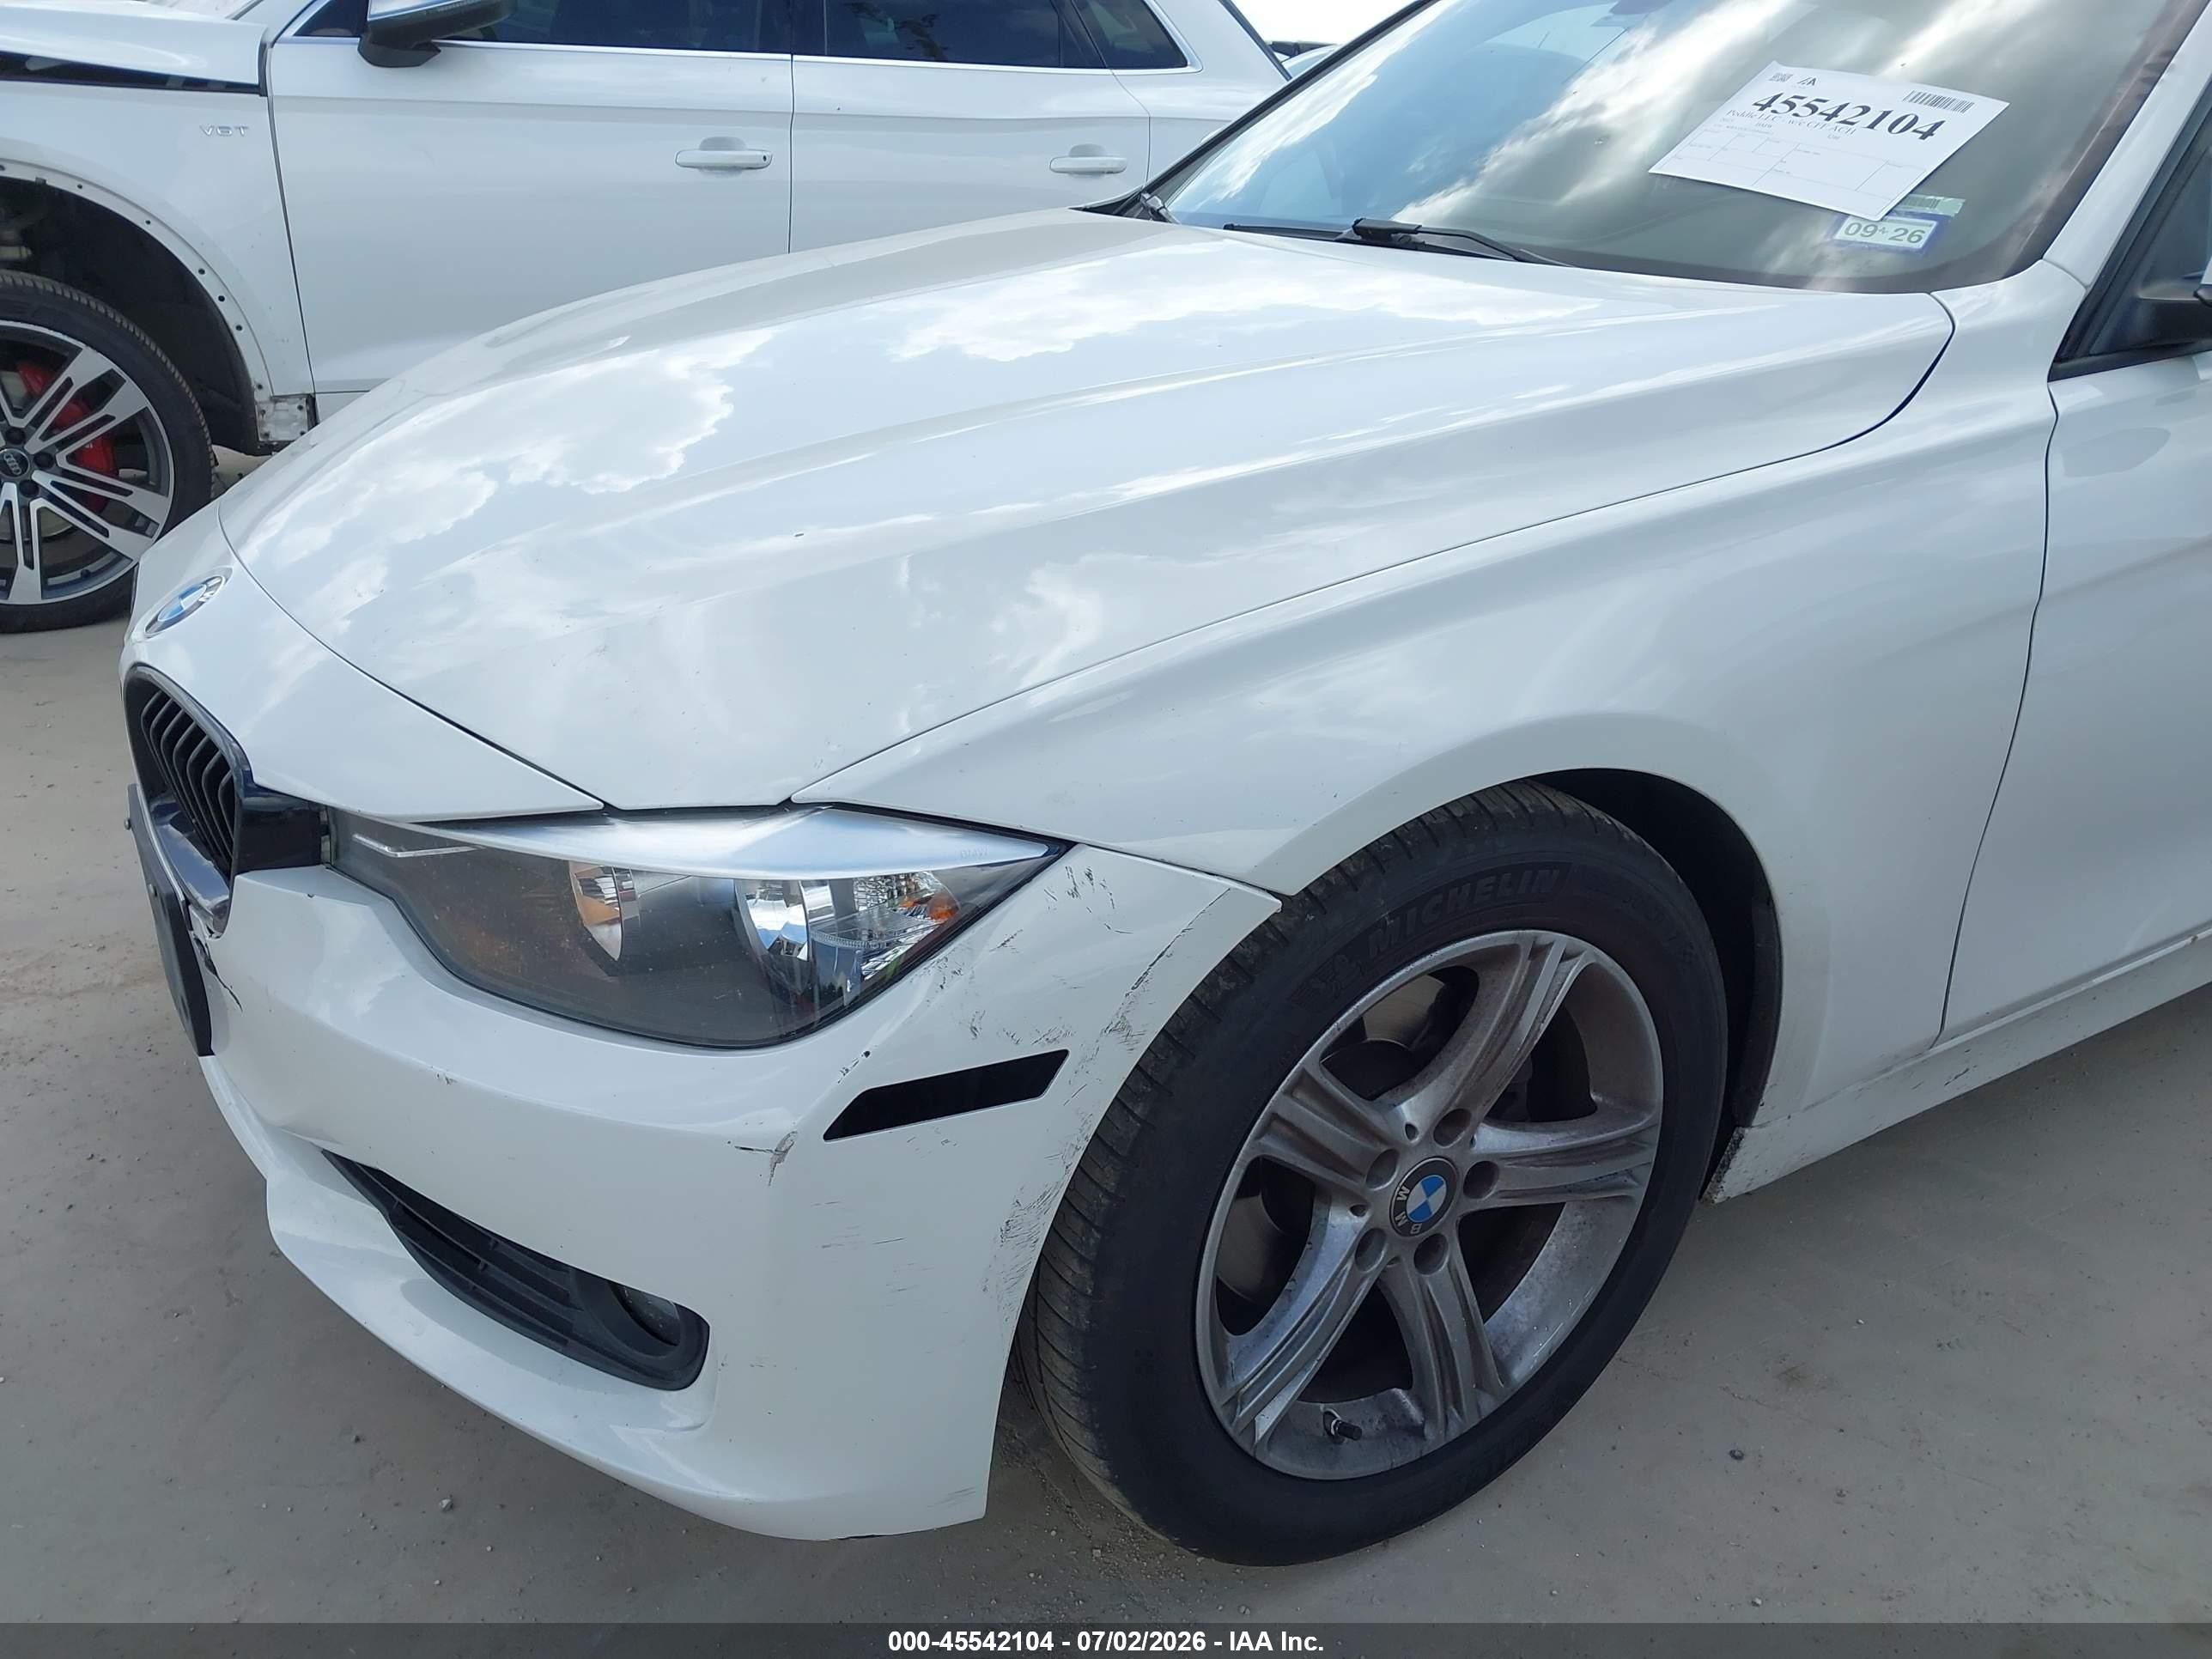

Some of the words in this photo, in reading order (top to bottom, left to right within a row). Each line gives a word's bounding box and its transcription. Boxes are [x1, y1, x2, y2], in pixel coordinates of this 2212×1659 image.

[199, 125, 249, 137] V6T
[1752, 92, 1947, 141] 45542104
[1844, 222, 1878, 238] 09
[1888, 228, 1925, 244] 26
[1366, 868, 1560, 957] MICHELIN
[1395, 1185, 1423, 1235] BMW
